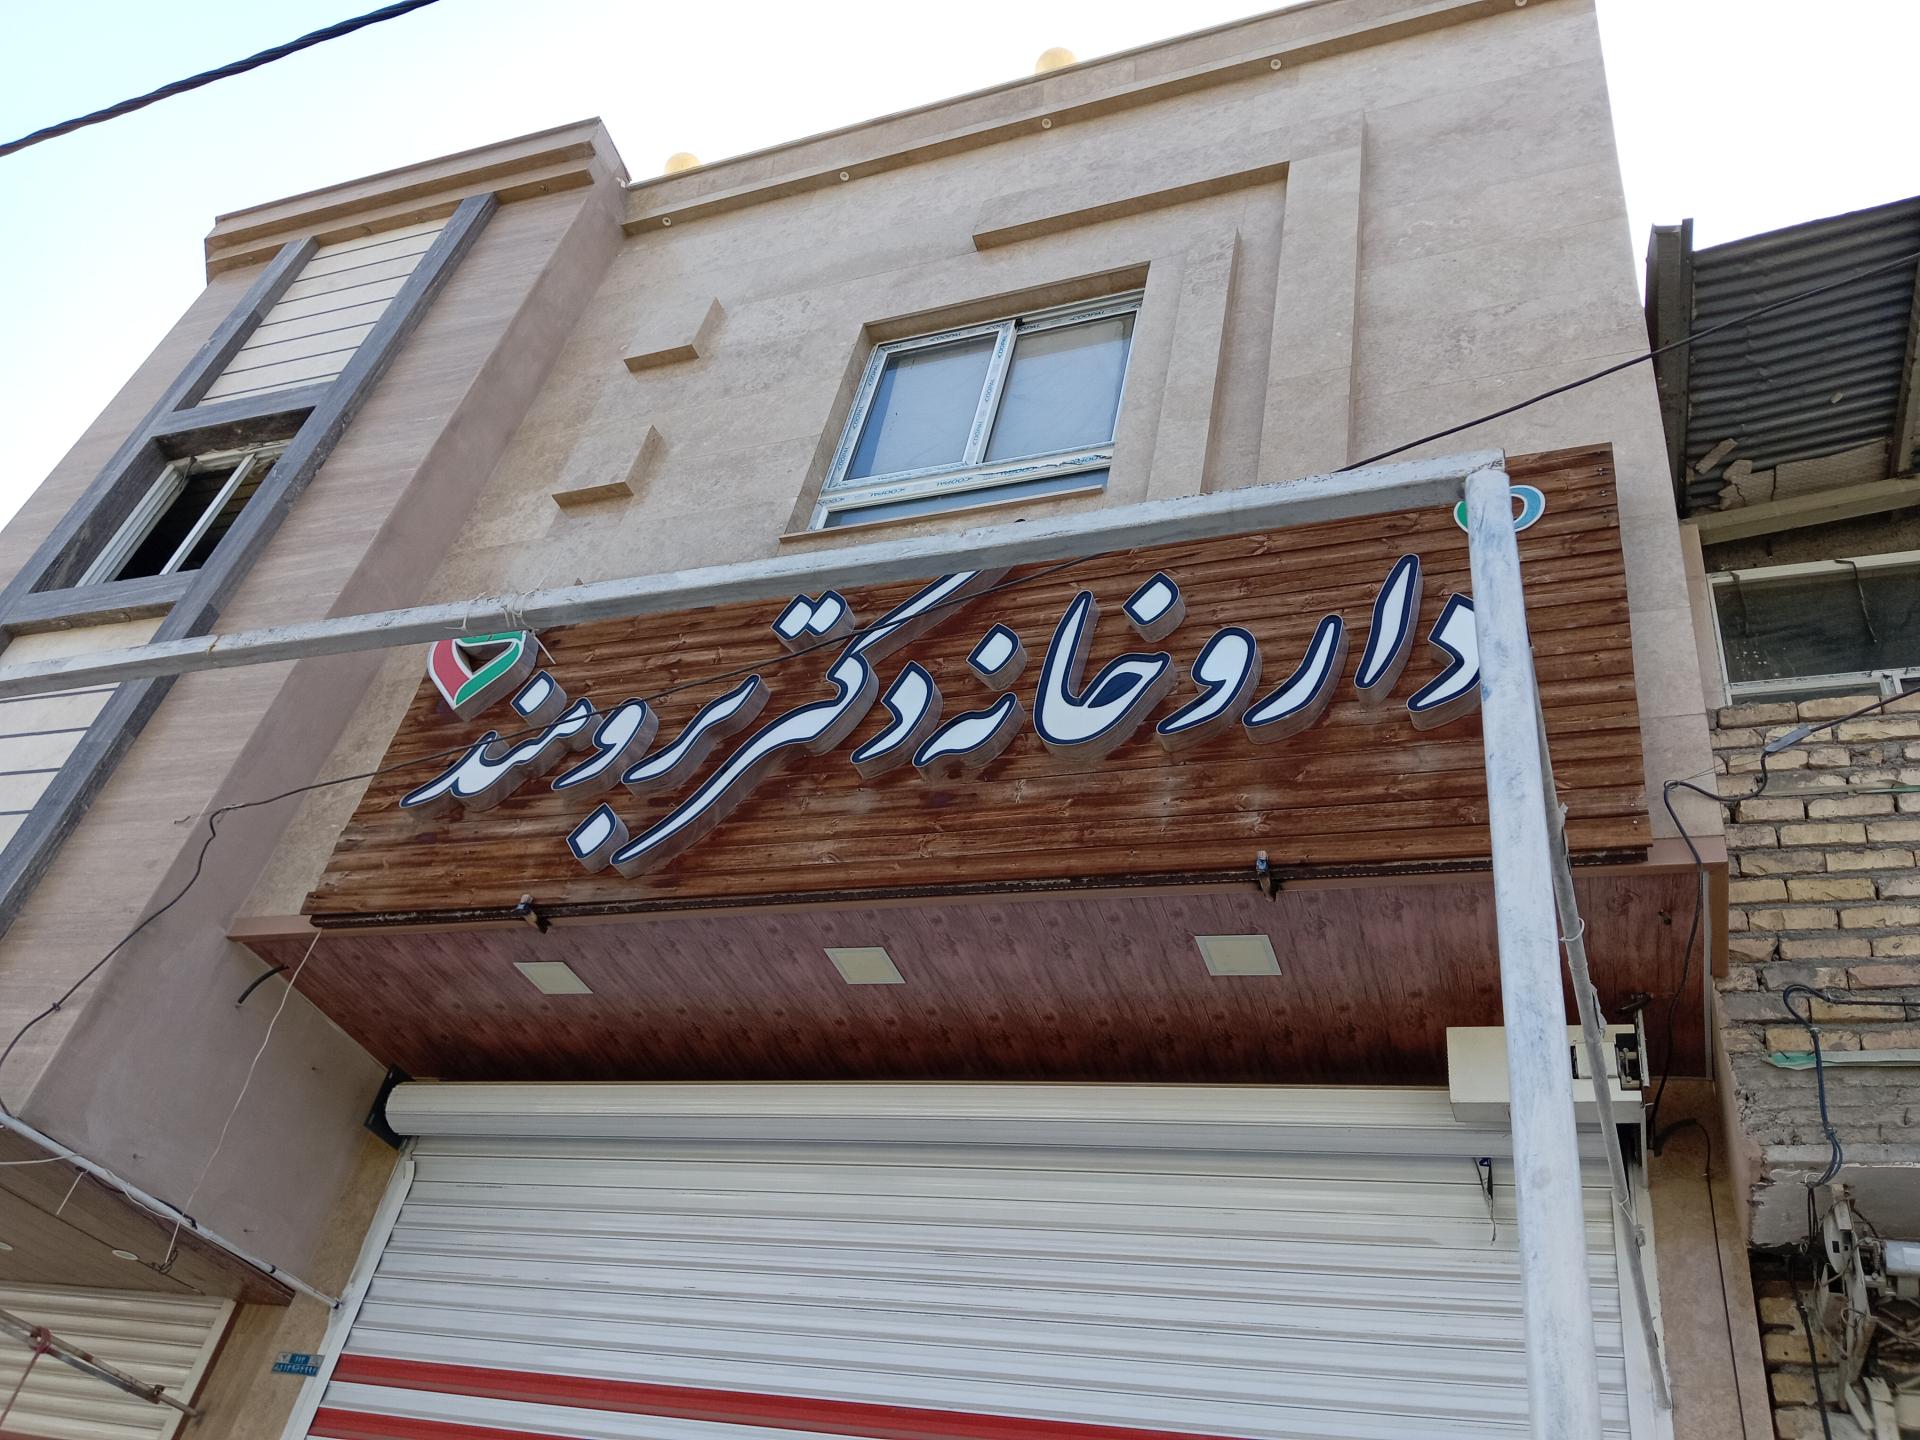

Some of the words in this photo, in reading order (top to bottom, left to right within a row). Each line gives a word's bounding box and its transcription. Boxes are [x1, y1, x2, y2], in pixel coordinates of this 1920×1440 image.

[400, 672, 762, 860] برومند
[610, 569, 986, 865] دکتر
[912, 553, 1483, 768] داروخانه
